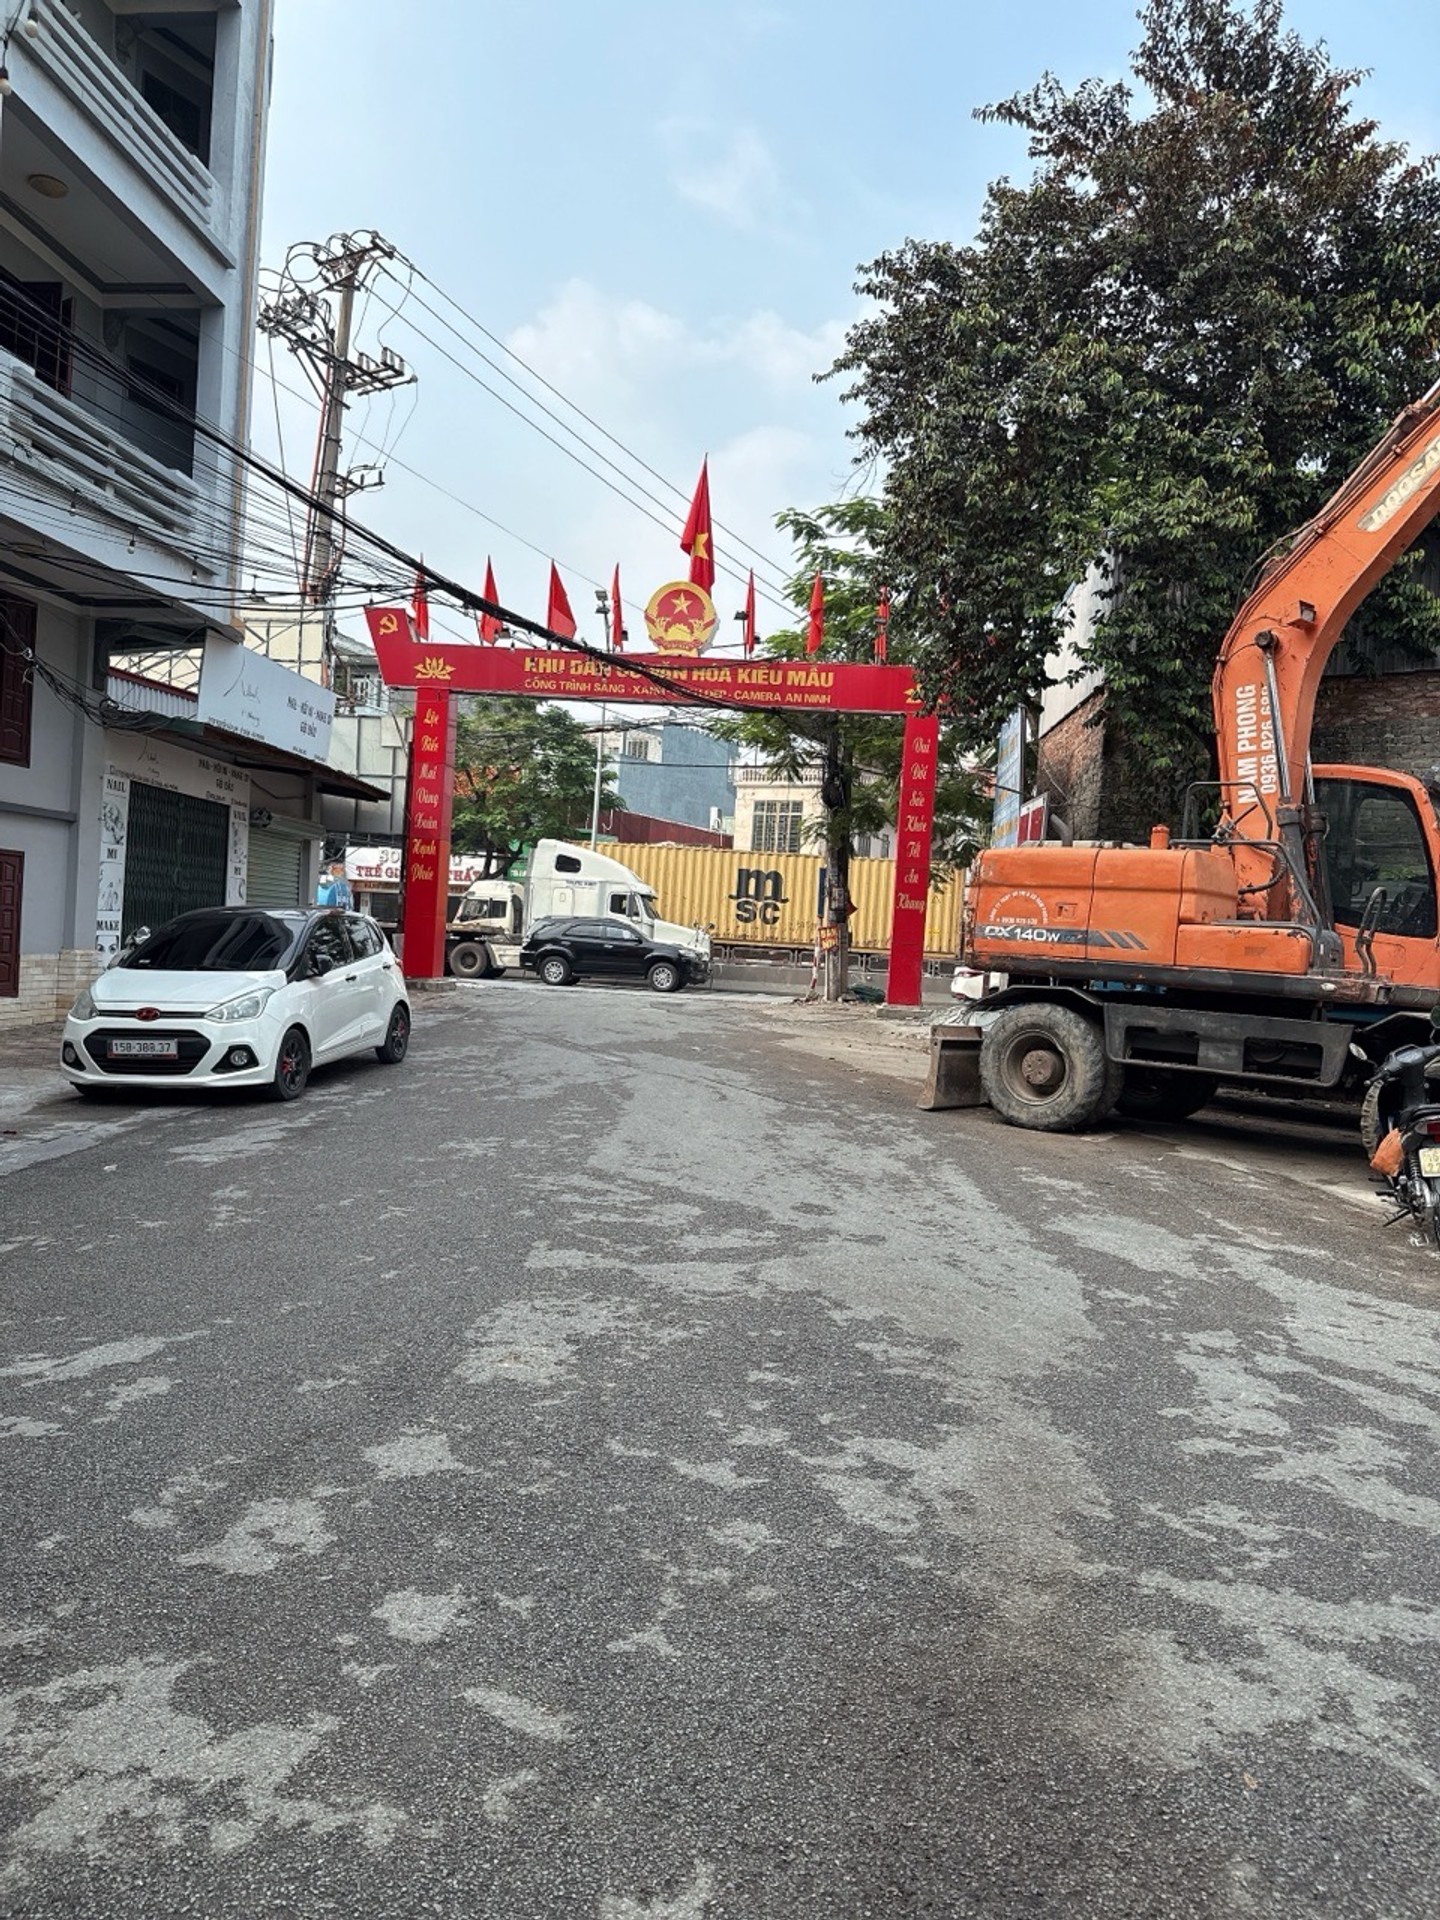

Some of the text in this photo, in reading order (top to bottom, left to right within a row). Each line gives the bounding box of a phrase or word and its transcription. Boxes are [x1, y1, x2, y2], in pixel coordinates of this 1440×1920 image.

[524, 656, 565, 674] KHU
[525, 677, 557, 690] CÔNG
[560, 679, 591, 692] TRÌNH
[734, 690, 781, 702] CAMERA
[785, 692, 800, 703] AN
[804, 693, 831, 704] NINH
[1235, 684, 1259, 804] NAM PHONG
[106, 778, 127, 793] NAIL
[449, 865, 482, 882] HẤT
[96, 920, 120, 932] MAKE
